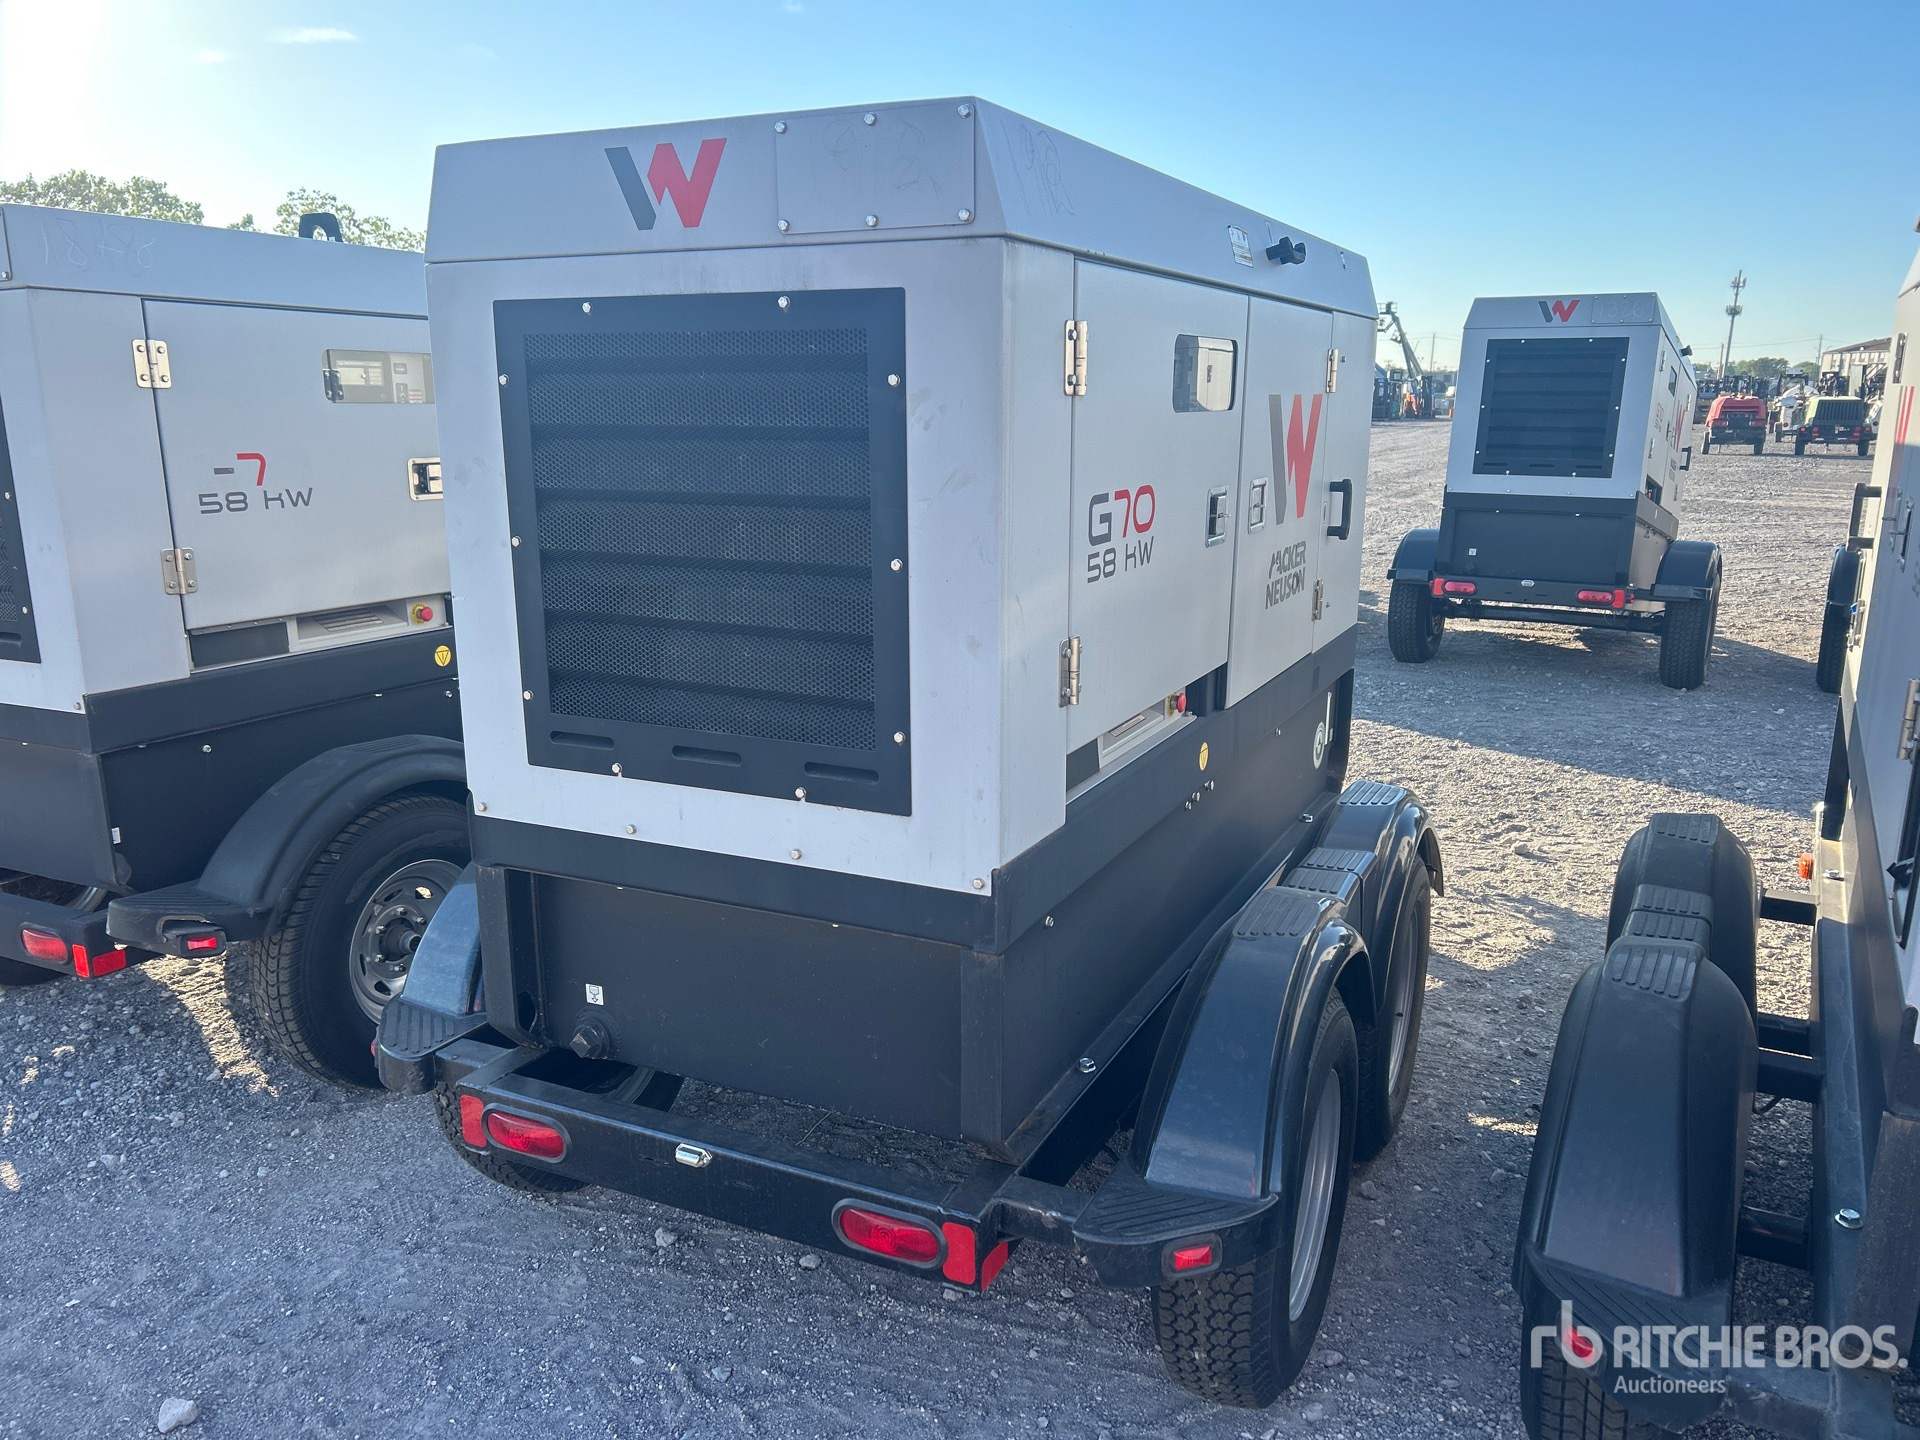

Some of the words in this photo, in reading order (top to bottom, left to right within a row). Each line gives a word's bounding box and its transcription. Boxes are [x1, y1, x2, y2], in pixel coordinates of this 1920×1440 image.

[198, 491, 249, 515] 58
[1088, 484, 1156, 547] G70
[1087, 547, 1117, 583] 58
[1268, 540, 1307, 580] ACKER
[1265, 567, 1306, 610] NEUSON
